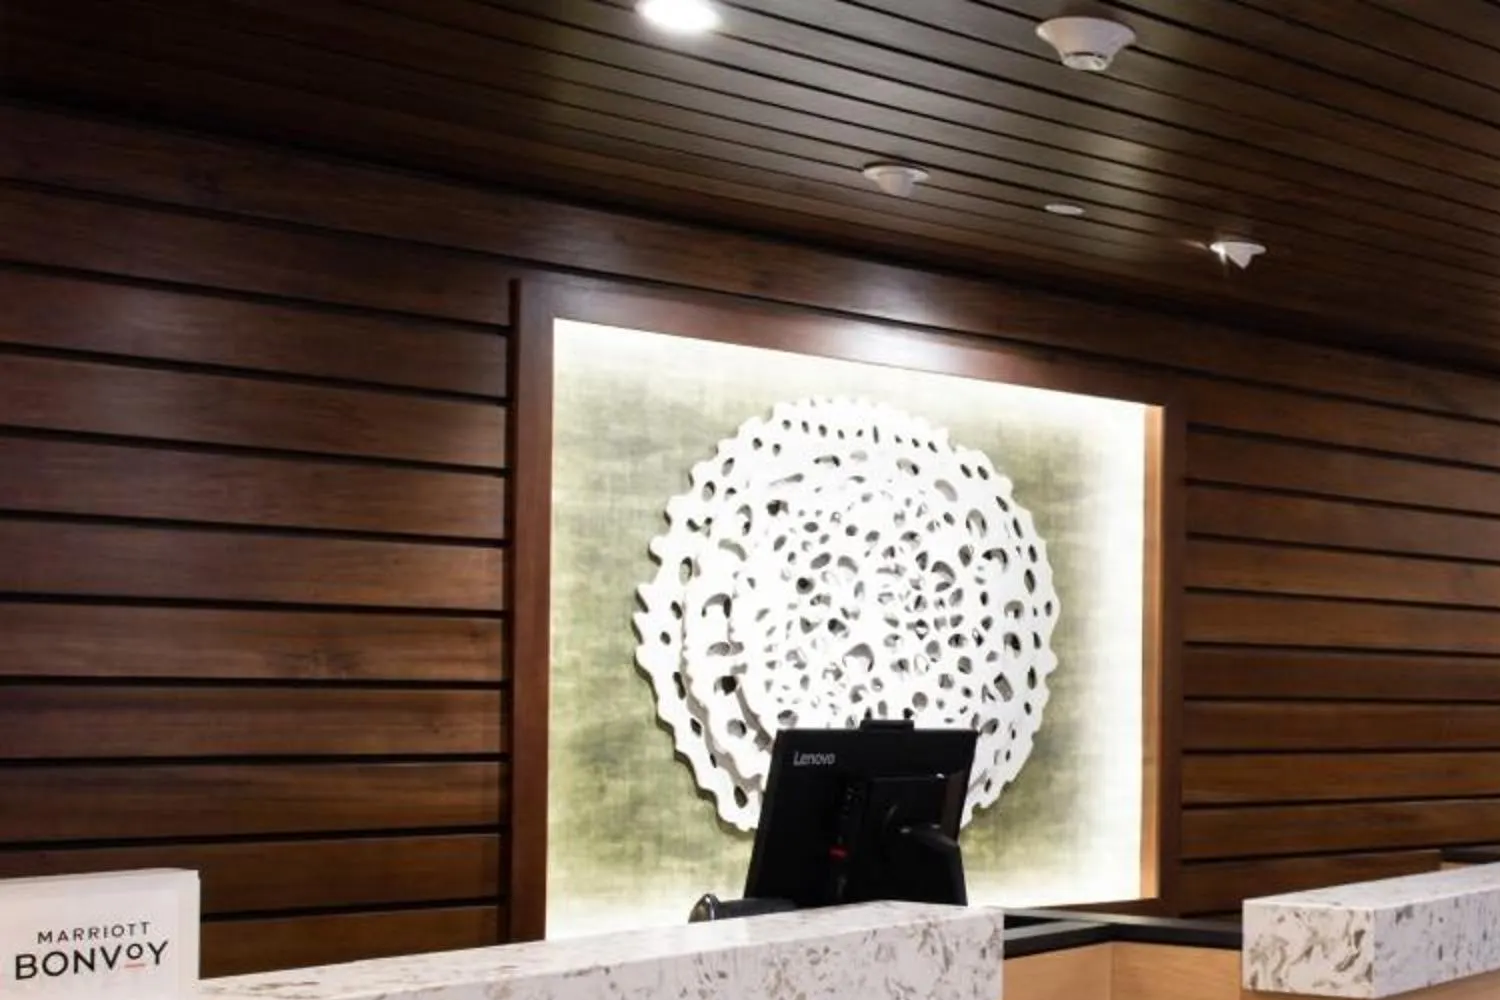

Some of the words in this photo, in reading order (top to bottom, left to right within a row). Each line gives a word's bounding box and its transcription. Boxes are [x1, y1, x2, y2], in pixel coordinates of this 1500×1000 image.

[793, 751, 836, 766] Lenovo
[37, 921, 151, 944] MARRIOTT
[15, 940, 169, 980] BONVOY
